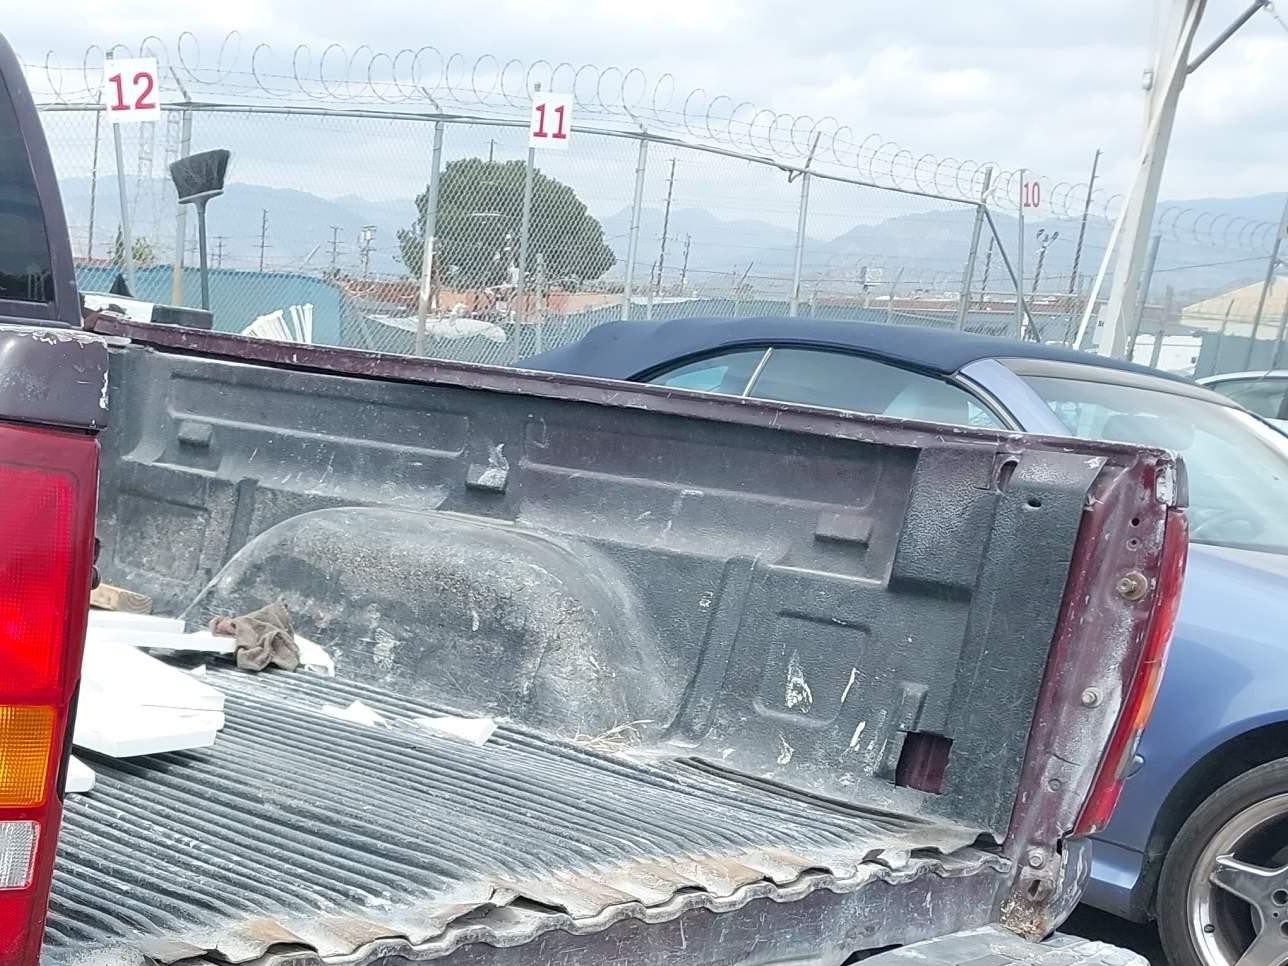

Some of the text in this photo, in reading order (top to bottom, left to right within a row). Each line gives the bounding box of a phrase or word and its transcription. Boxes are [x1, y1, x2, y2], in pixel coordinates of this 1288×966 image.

[109, 72, 156, 110] 12
[533, 103, 567, 139] 11
[1023, 182, 1041, 208] 10
